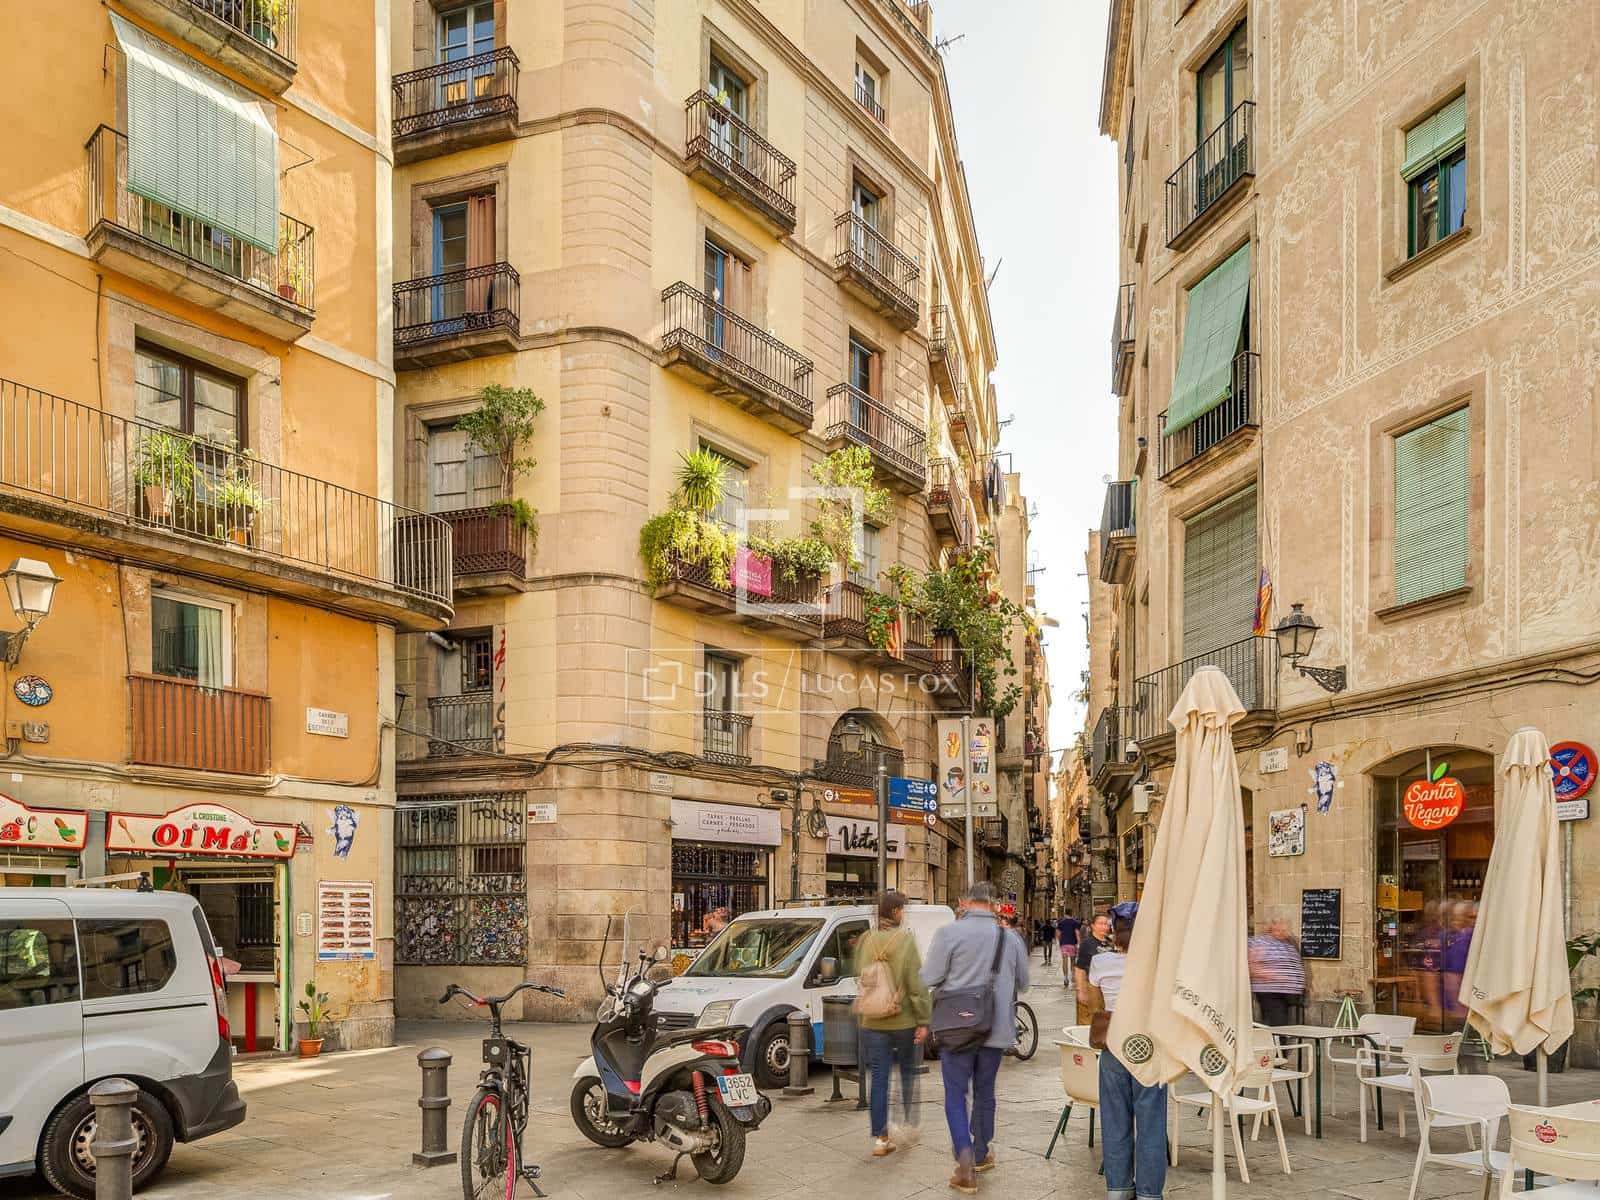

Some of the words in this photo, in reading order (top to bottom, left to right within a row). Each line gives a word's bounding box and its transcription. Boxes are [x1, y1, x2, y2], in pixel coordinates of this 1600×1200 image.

[1407, 781, 1458, 803] Santa
[1404, 803, 1459, 826] Vegana
[726, 1076, 753, 1089] 3652
[729, 1088, 750, 1101] LVC
